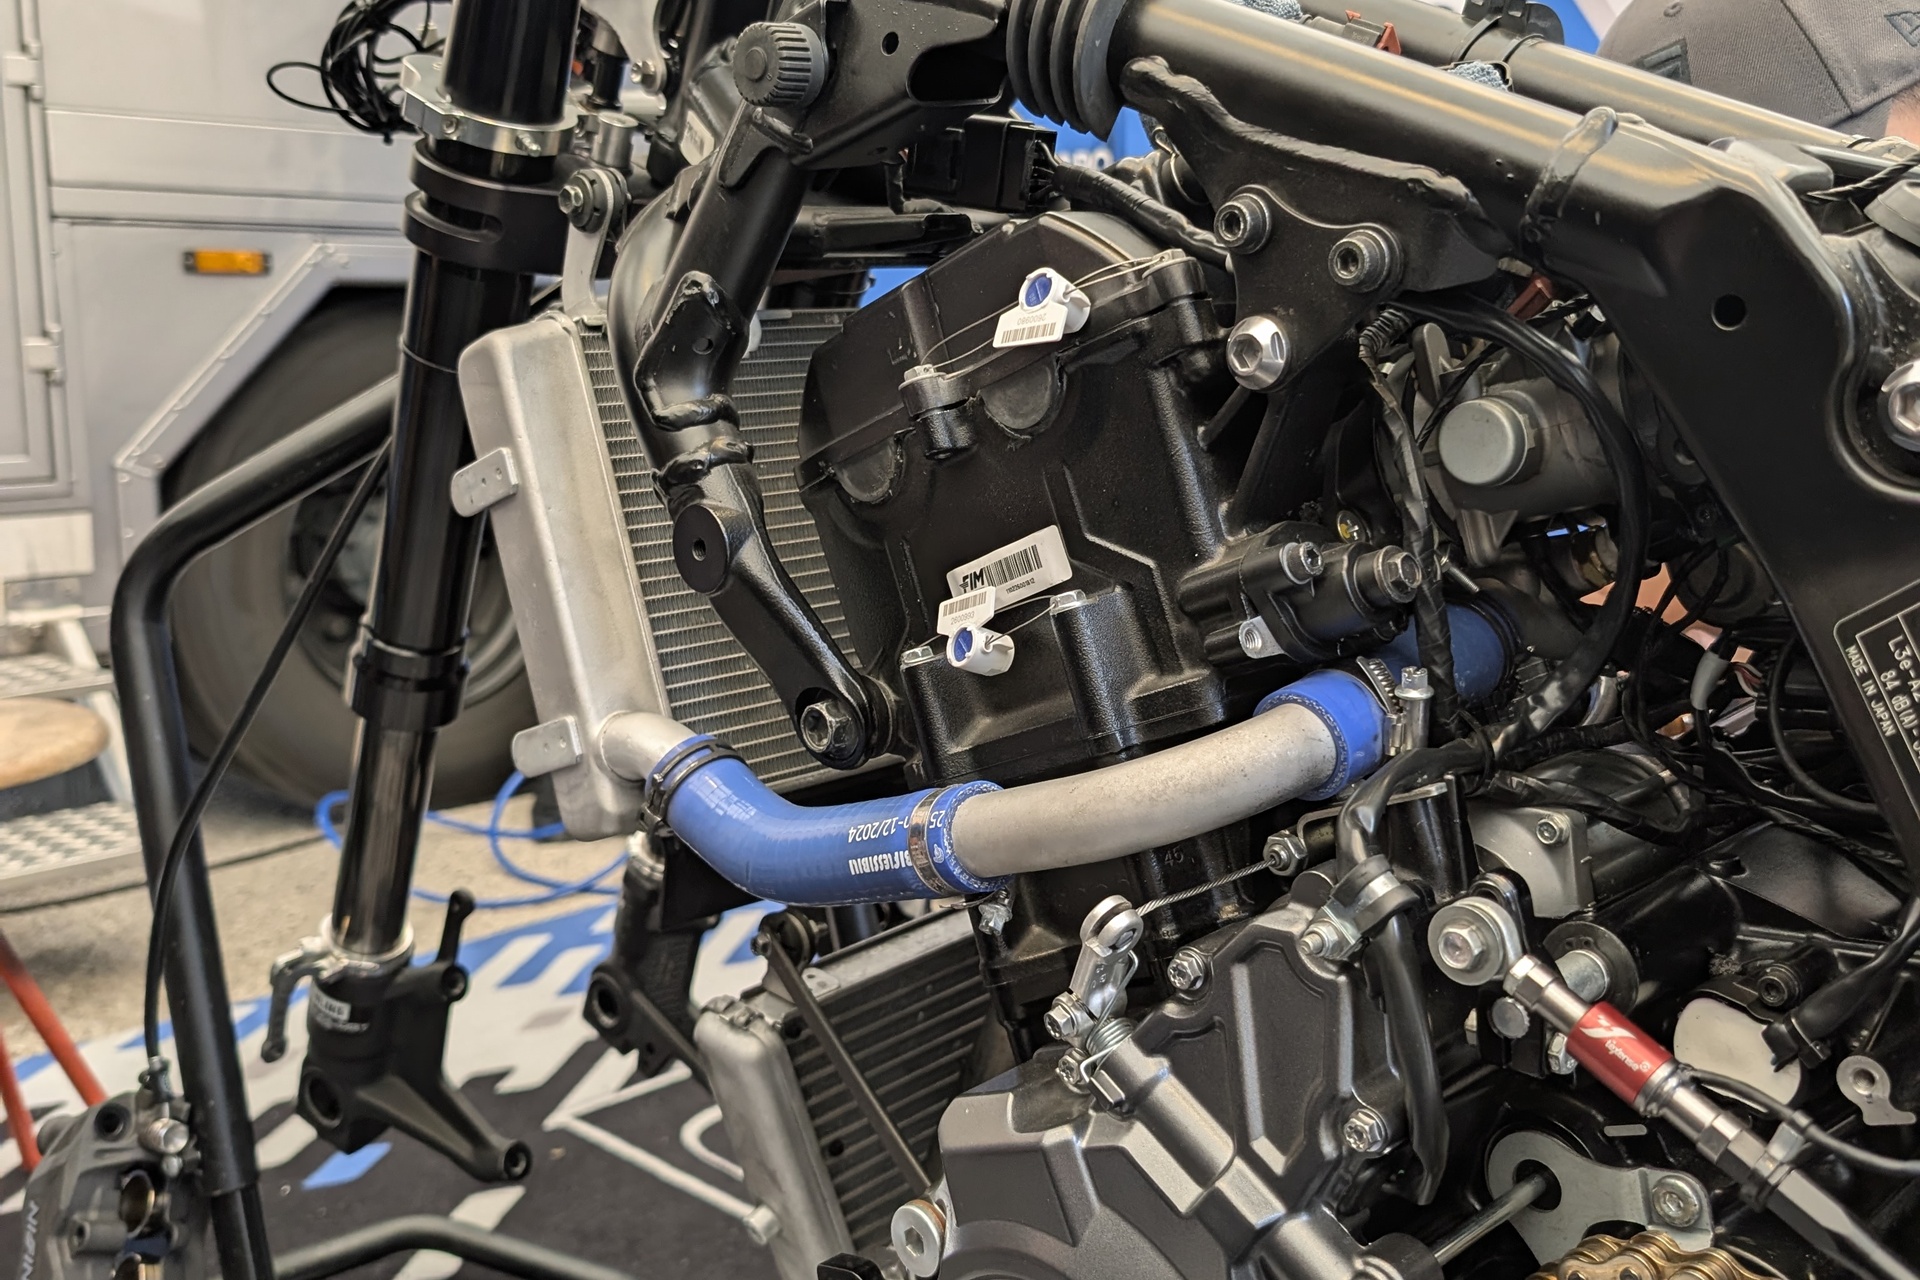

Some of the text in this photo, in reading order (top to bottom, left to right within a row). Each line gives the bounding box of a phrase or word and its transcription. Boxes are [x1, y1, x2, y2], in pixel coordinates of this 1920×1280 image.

[959, 567, 985, 594] FIM
[1844, 643, 1898, 738] MADE IN JAPAN
[1880, 669, 1901, 691] 84
